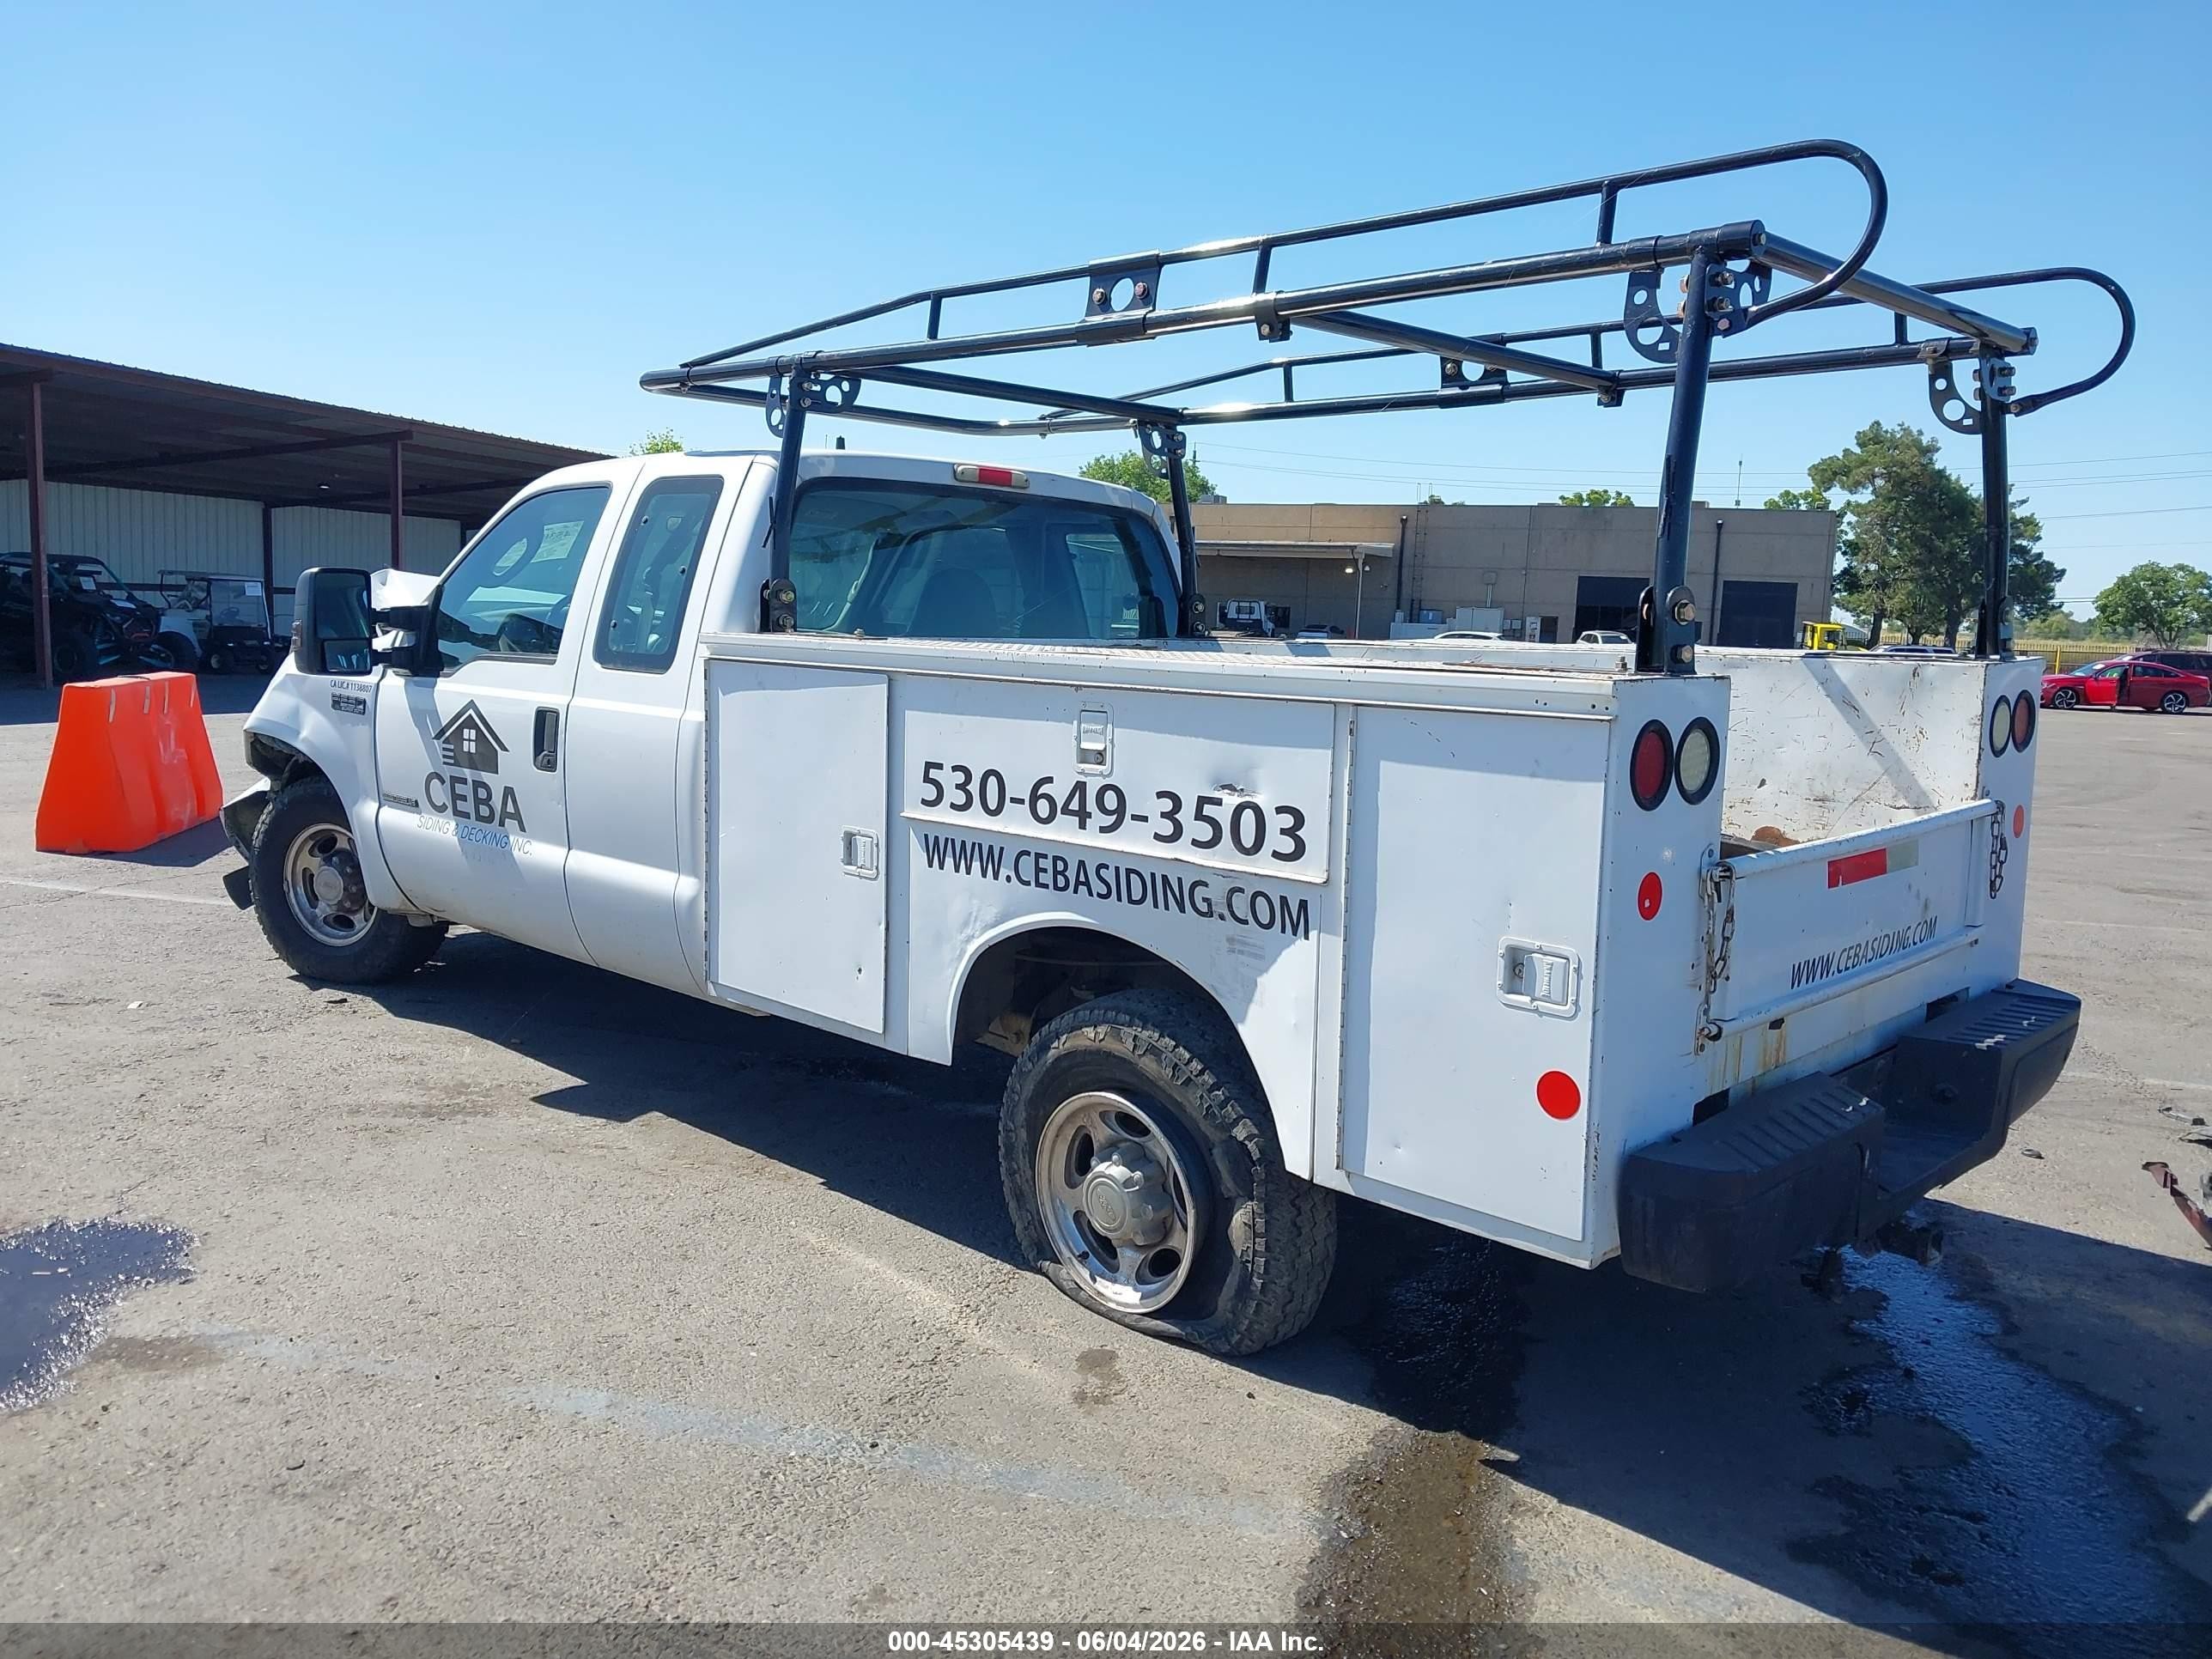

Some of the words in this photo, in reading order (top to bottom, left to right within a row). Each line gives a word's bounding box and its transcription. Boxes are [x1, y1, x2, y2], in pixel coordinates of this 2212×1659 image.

[417, 815, 450, 835] SIDING
[453, 823, 459, 836] &
[460, 825, 509, 849] DECKING
[510, 836, 532, 856] INC.
[424, 772, 526, 833] CEBA
[920, 761, 1306, 862] 530-649-3503
[924, 833, 1310, 940] WWW.CEBASIDING.COM
[1790, 915, 1937, 989] WWW.CEBASIDING.COM
